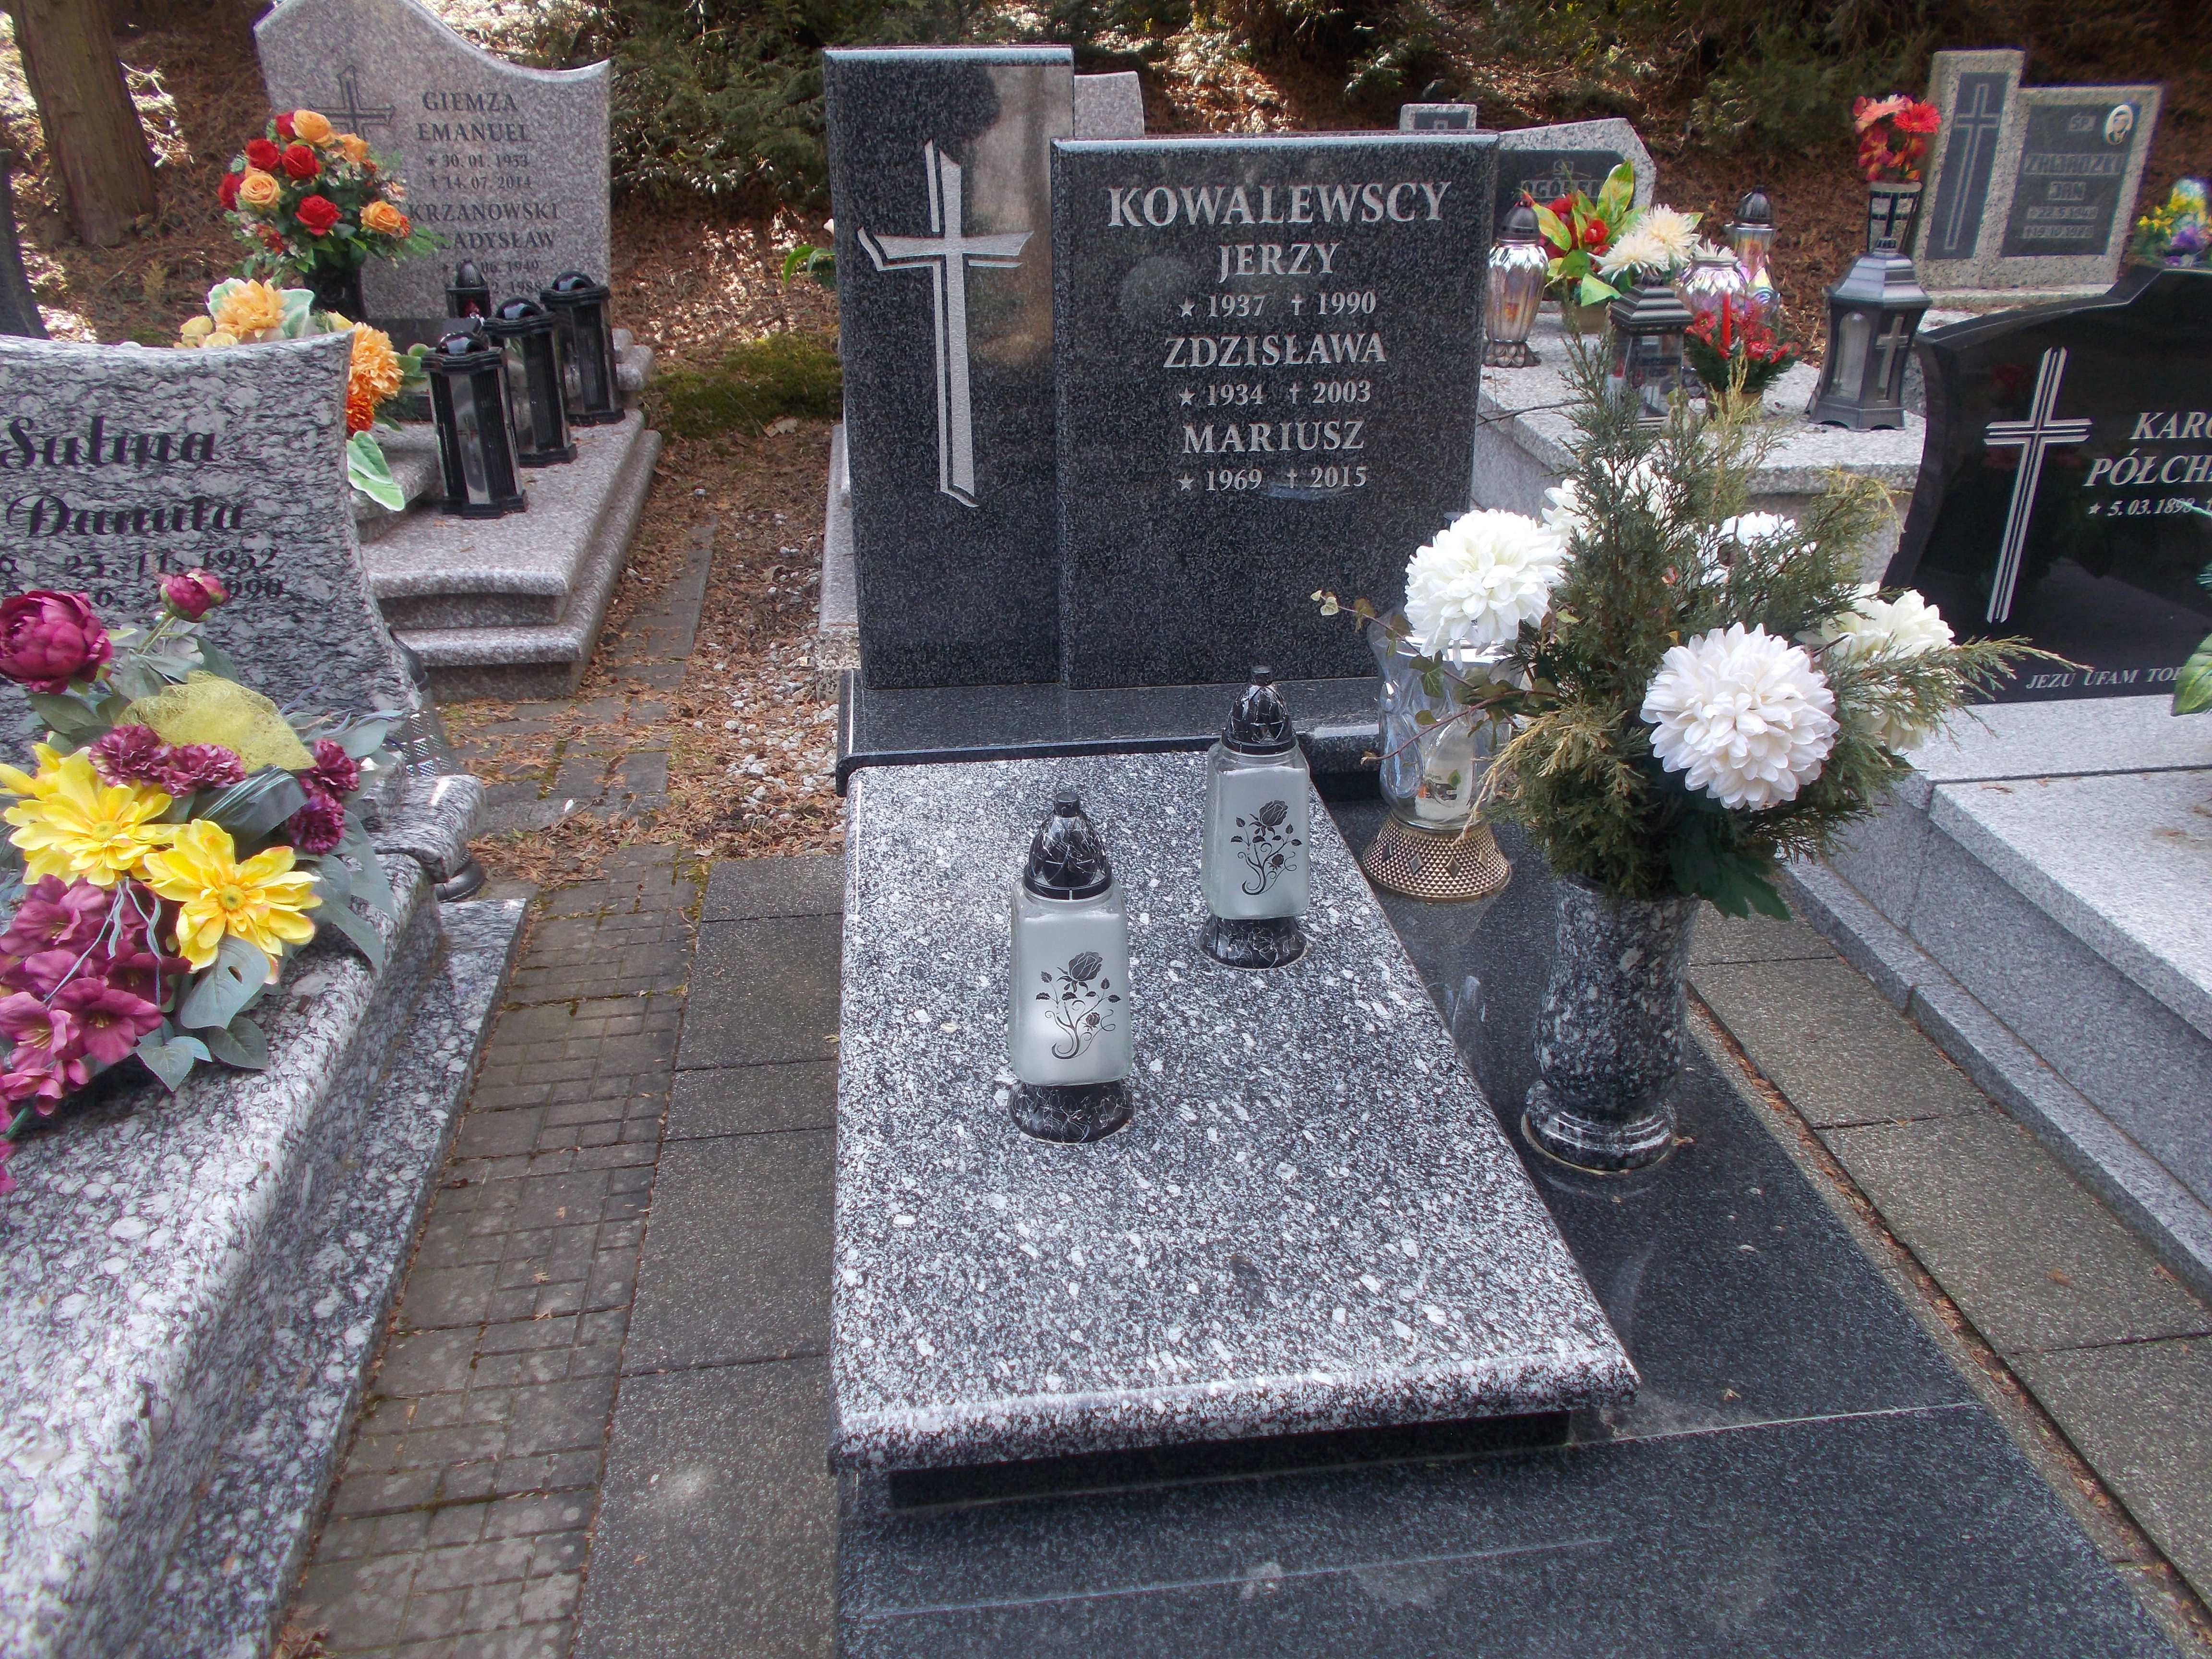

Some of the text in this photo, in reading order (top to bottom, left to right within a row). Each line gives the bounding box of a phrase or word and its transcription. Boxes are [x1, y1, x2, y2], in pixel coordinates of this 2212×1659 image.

[417, 123, 531, 141] EMANUEL
[409, 203, 559, 221] KRZANOWSKI
[1107, 181, 1452, 227] KOWALEWSCY
[438, 231, 553, 249] ADYSŁAW
[1218, 242, 1340, 283] JERZY
[1208, 291, 1376, 317] 1937 1990
[1163, 332, 1387, 368] ZDZISŁAWA
[1207, 380, 1371, 406] 1934 2003
[1182, 420, 1365, 453] MARIUSZ
[2129, 411, 2212, 440] KAR
[1205, 466, 1367, 491] 1969 2015
[2082, 447, 2212, 486] PÓŁCH
[6, 493, 244, 537] Danuta
[224, 578, 283, 600] 990
[2026, 673, 2076, 689] JEZU
[2084, 669, 2139, 685] UFAM
